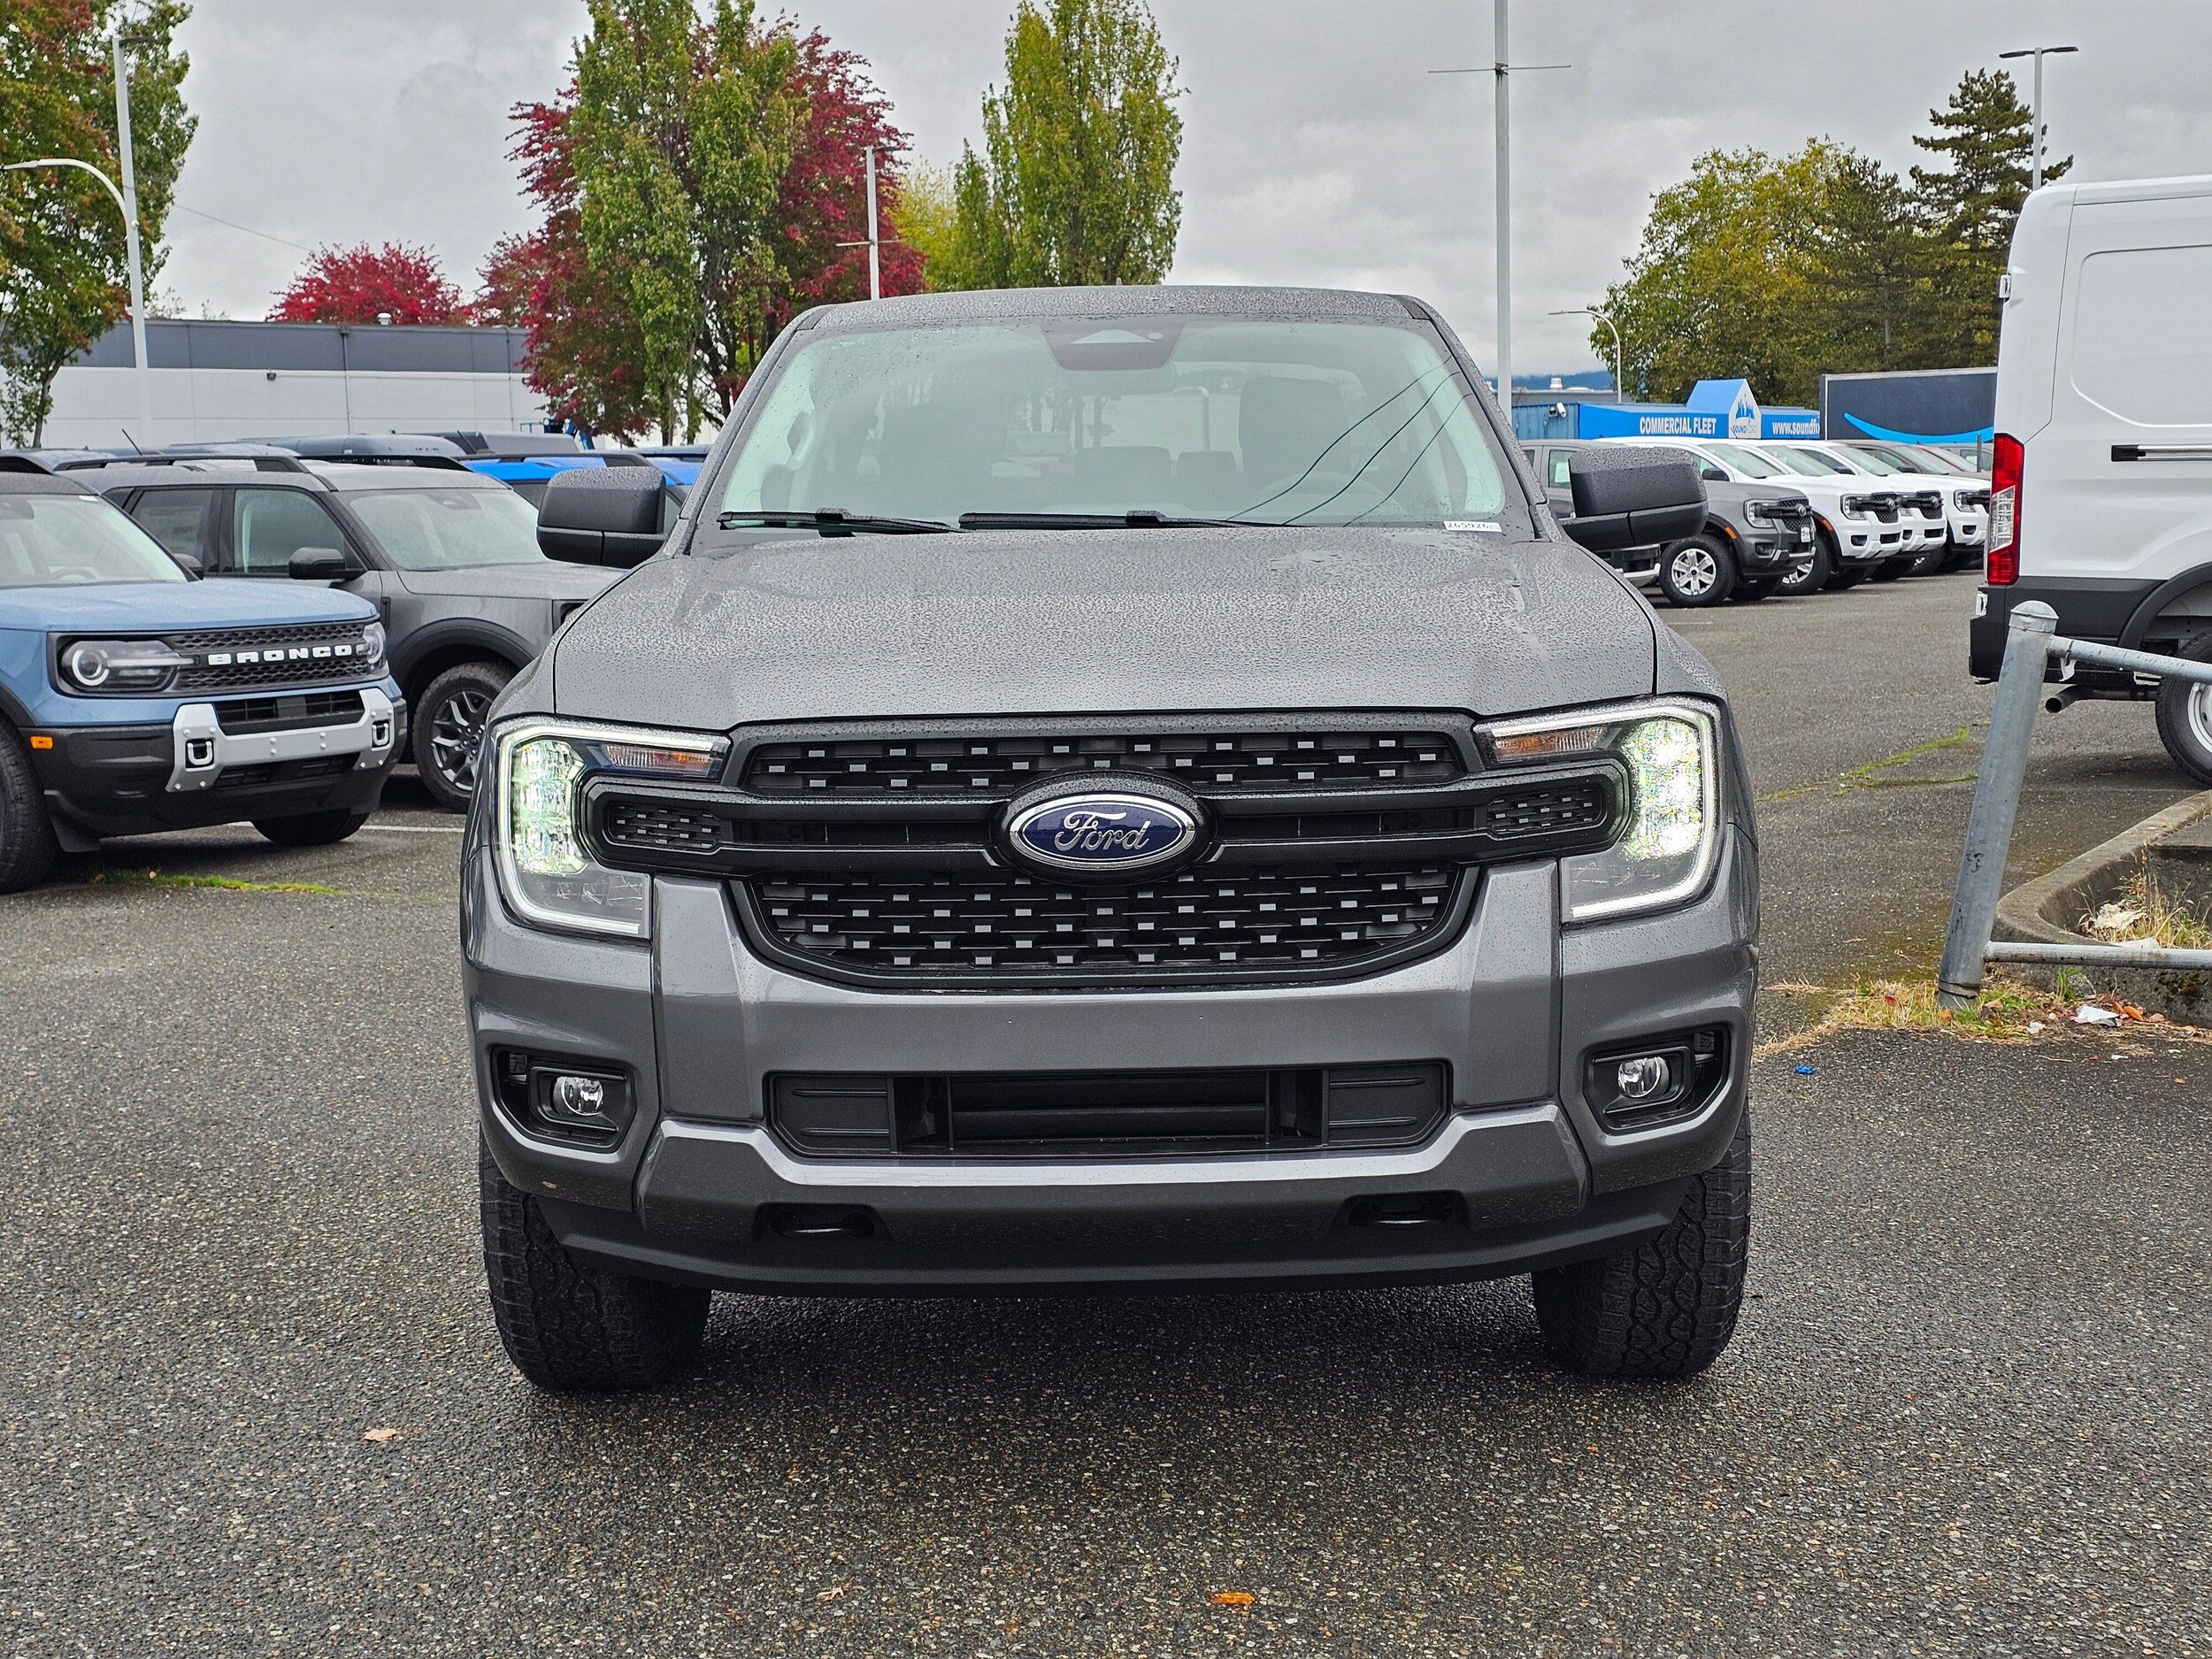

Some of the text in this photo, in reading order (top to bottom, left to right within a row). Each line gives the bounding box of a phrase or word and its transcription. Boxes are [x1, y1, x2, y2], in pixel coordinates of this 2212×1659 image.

[1640, 417, 1717, 434] COMMERCIAL FLEET
[208, 645, 352, 665] BRONCO
[1054, 811, 1151, 851] Ford
